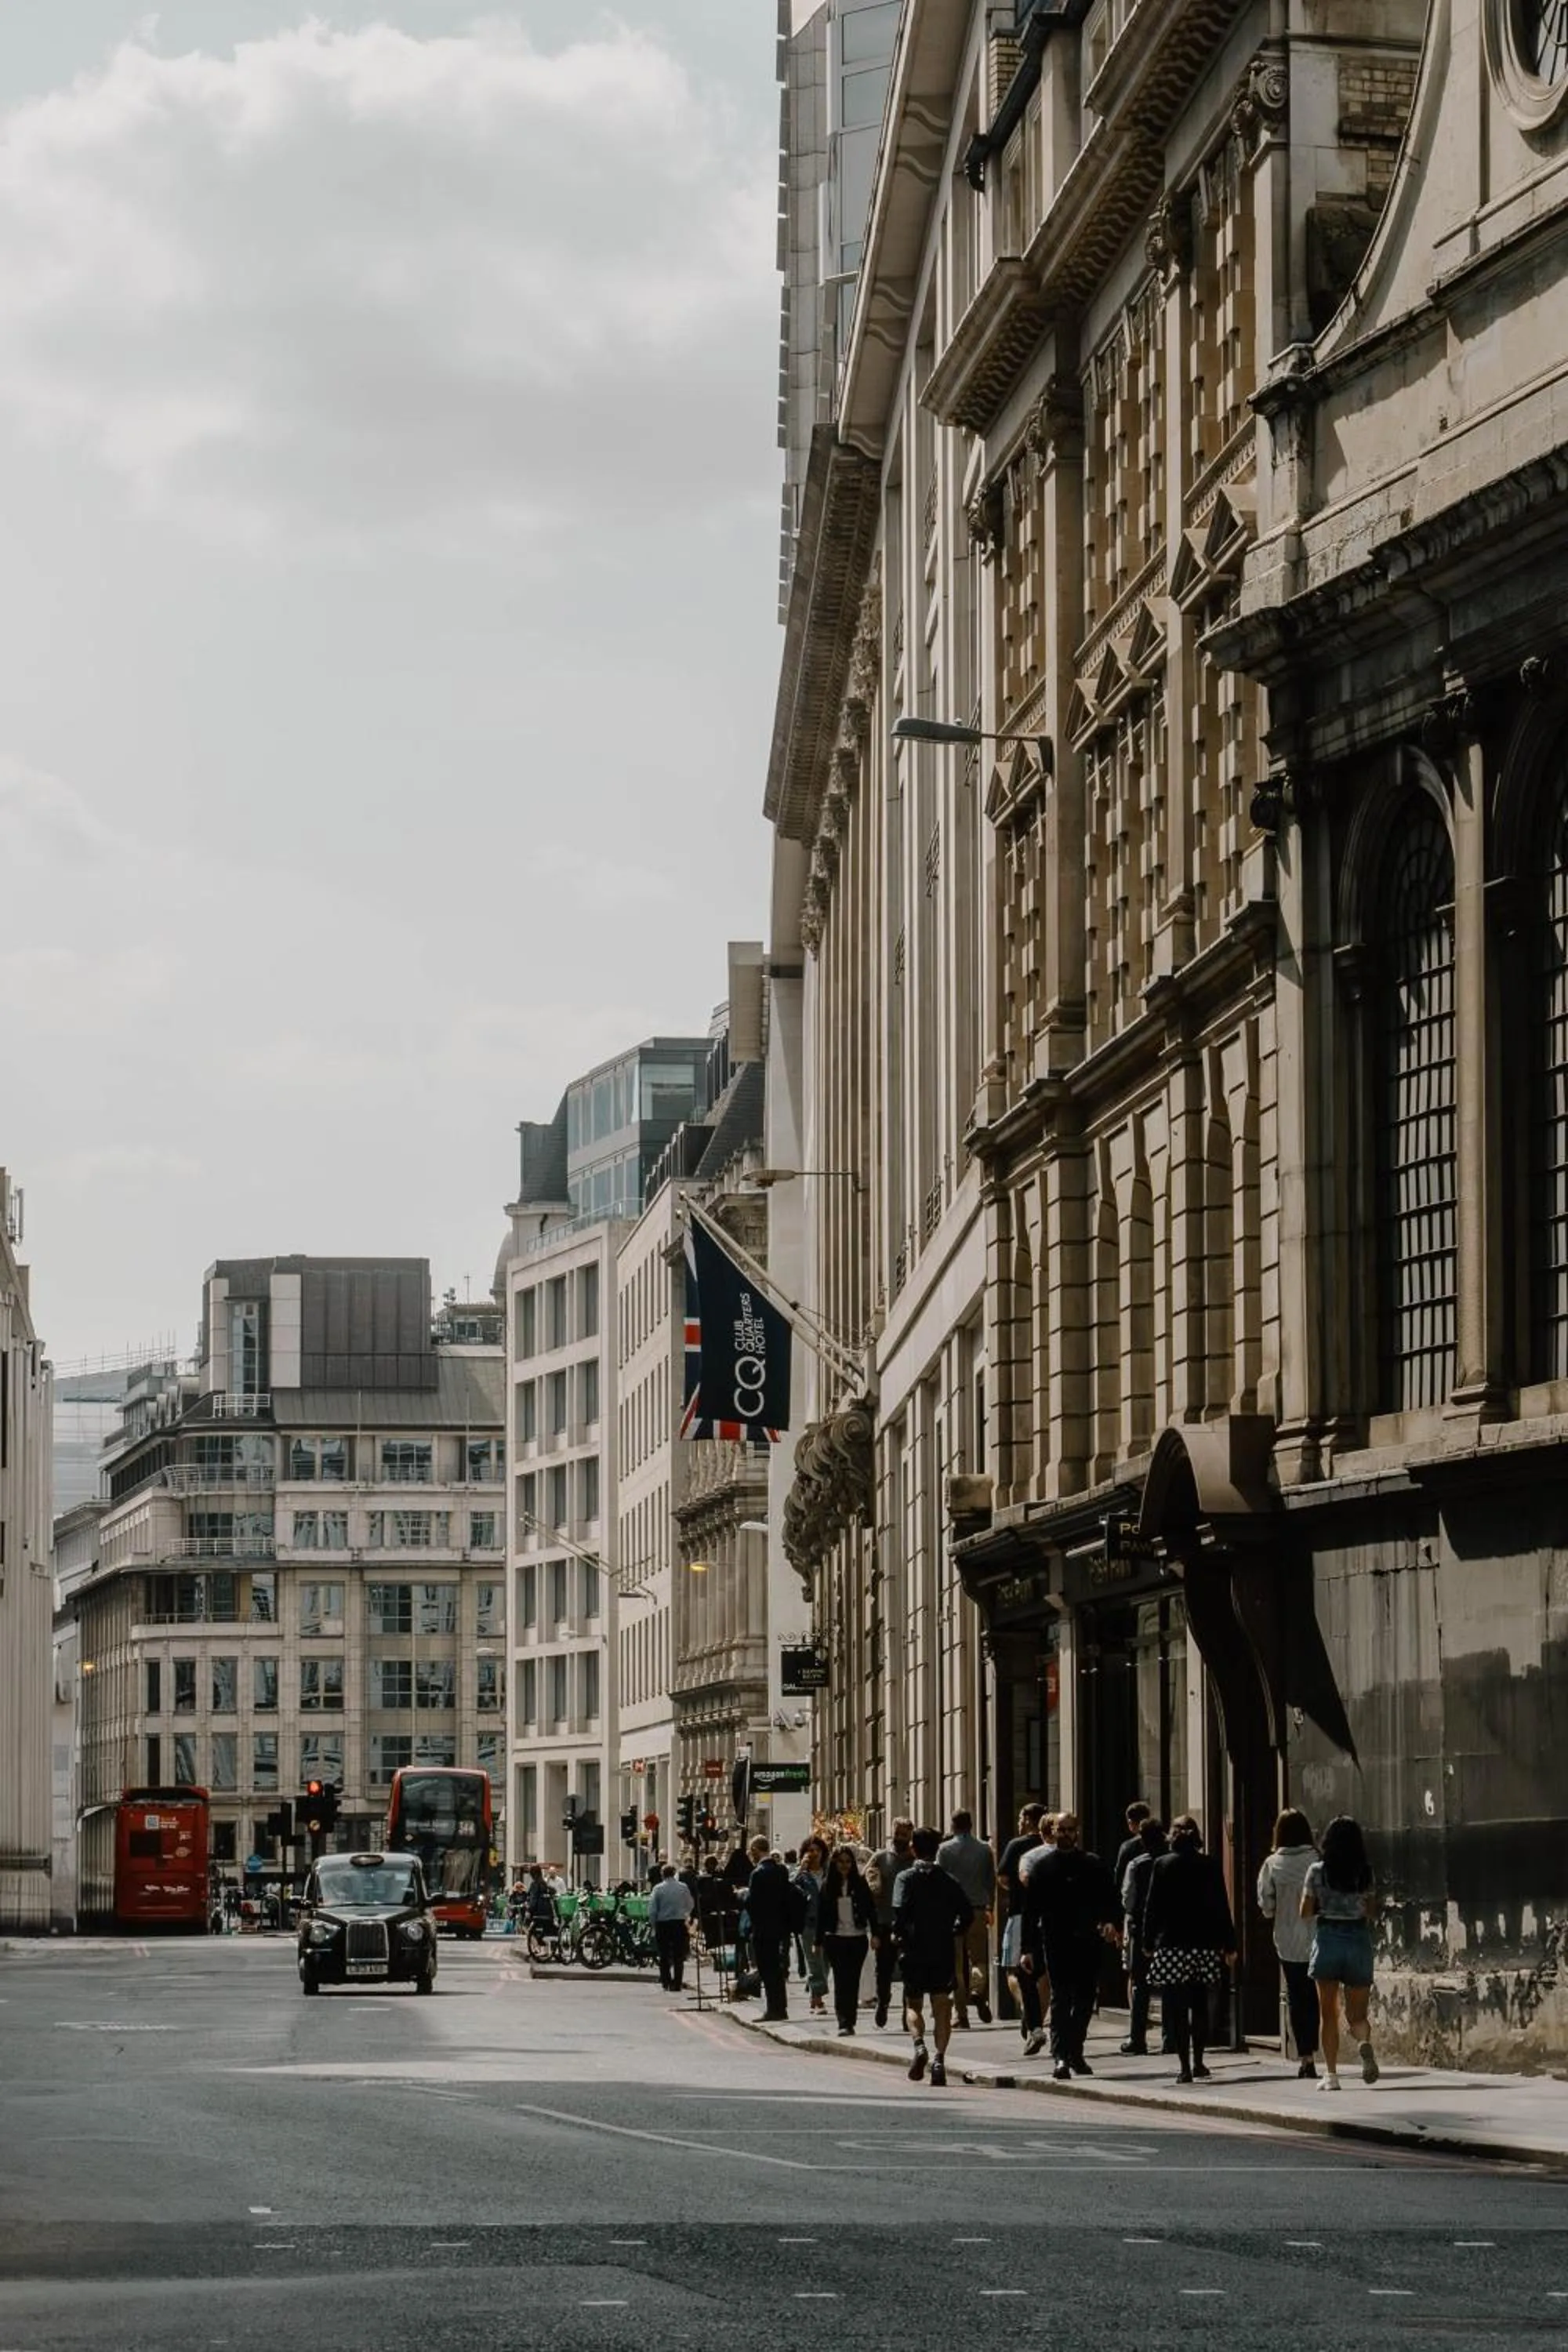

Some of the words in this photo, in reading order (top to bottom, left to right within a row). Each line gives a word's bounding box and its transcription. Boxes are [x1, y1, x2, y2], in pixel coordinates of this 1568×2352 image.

[734, 1320, 745, 1351] CLUB
[741, 1293, 755, 1352] QUARTERS
[755, 1318, 766, 1354] HOTEL
[734, 1356, 766, 1417] CQ
